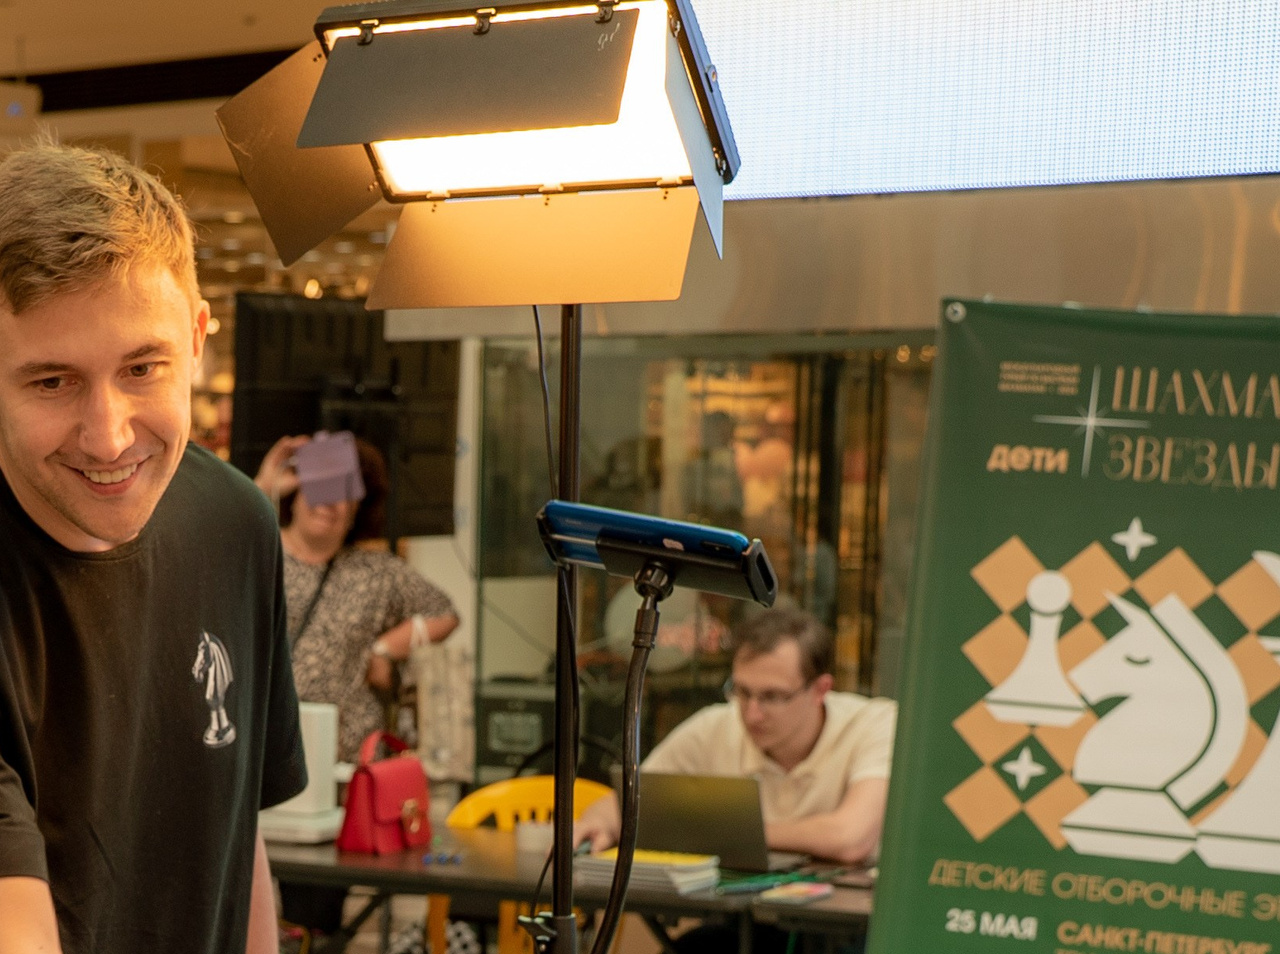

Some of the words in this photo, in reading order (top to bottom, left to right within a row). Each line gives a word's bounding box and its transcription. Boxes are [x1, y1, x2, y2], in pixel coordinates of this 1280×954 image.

[986, 443, 1070, 475] дети
[928, 858, 1047, 896] ДЕТСКИЕ
[1051, 871, 1247, 919] ОТБОРОЧНЫЕ
[945, 907, 976, 934] 25
[979, 911, 1038, 941] МАЯ
